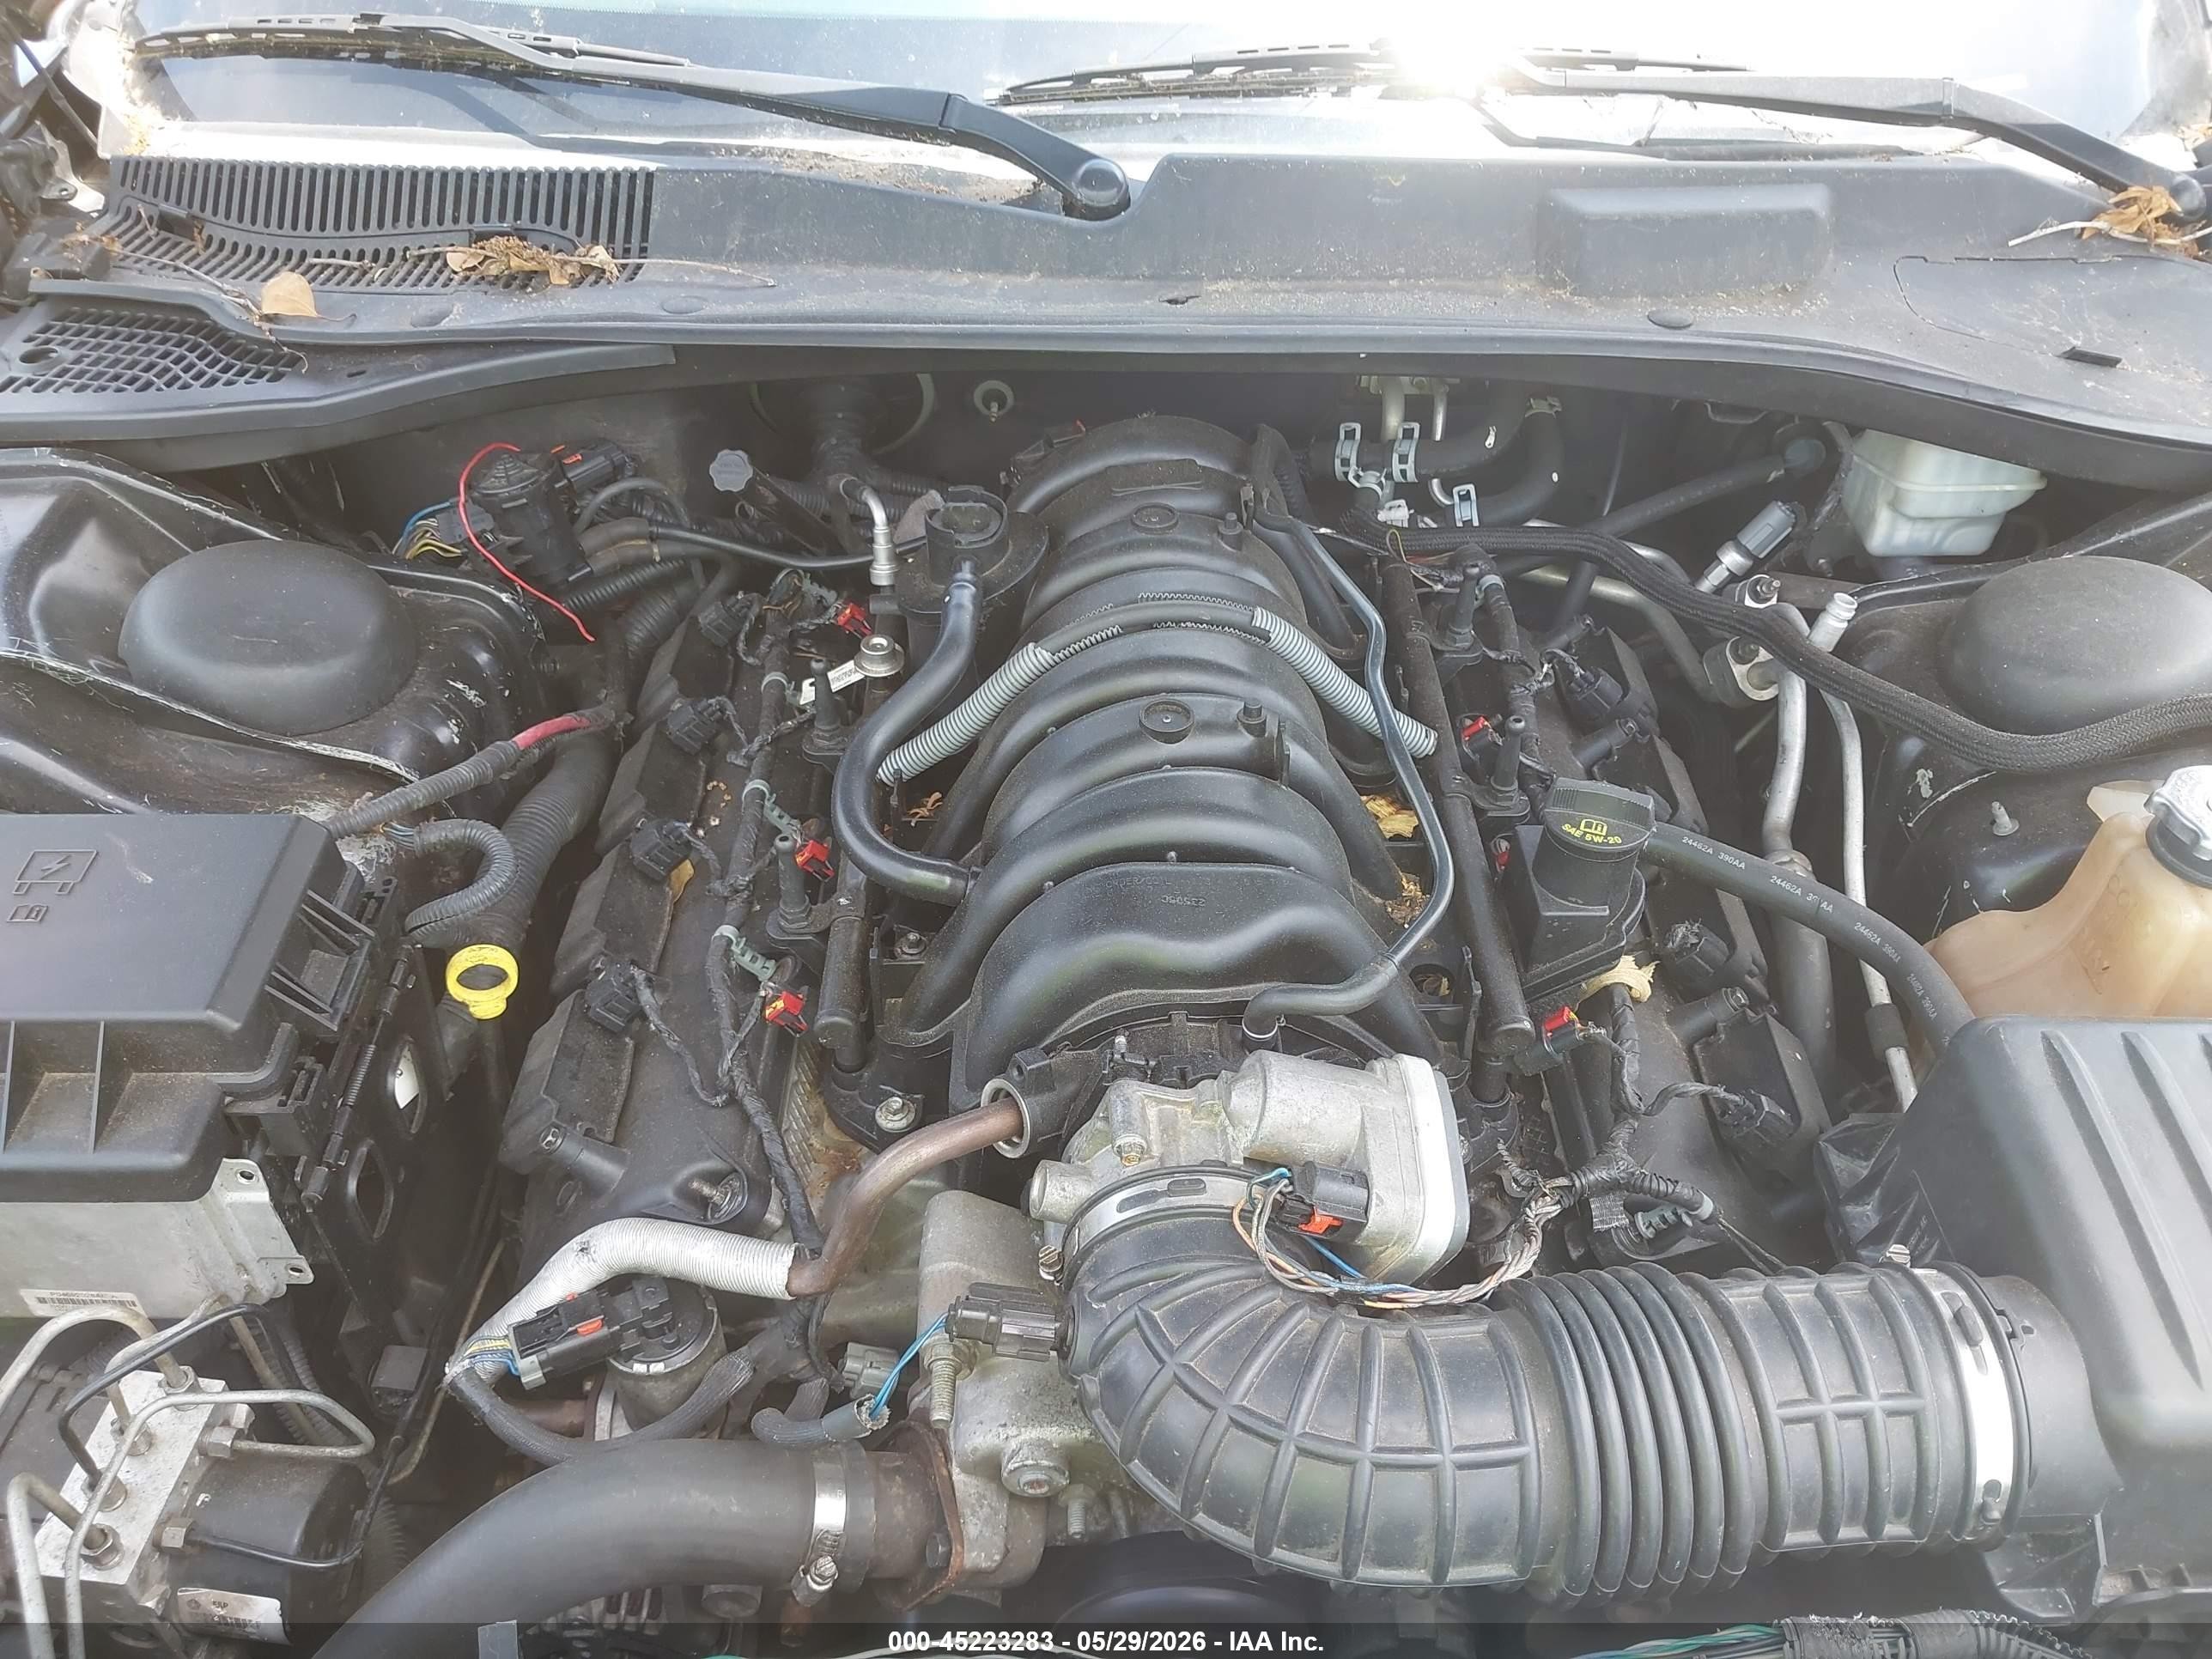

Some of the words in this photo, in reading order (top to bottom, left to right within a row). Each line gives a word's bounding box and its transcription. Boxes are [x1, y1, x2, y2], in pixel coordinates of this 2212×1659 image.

[1562, 823, 1583, 838] SAE
[1585, 833, 1622, 844] 5W-20
[1682, 836, 1713, 854] 24462A
[1717, 852, 1746, 869] 390AA
[1770, 875, 1802, 896] 24462A
[1806, 893, 1833, 914] 3AA
[1854, 921, 1881, 945] 24462A
